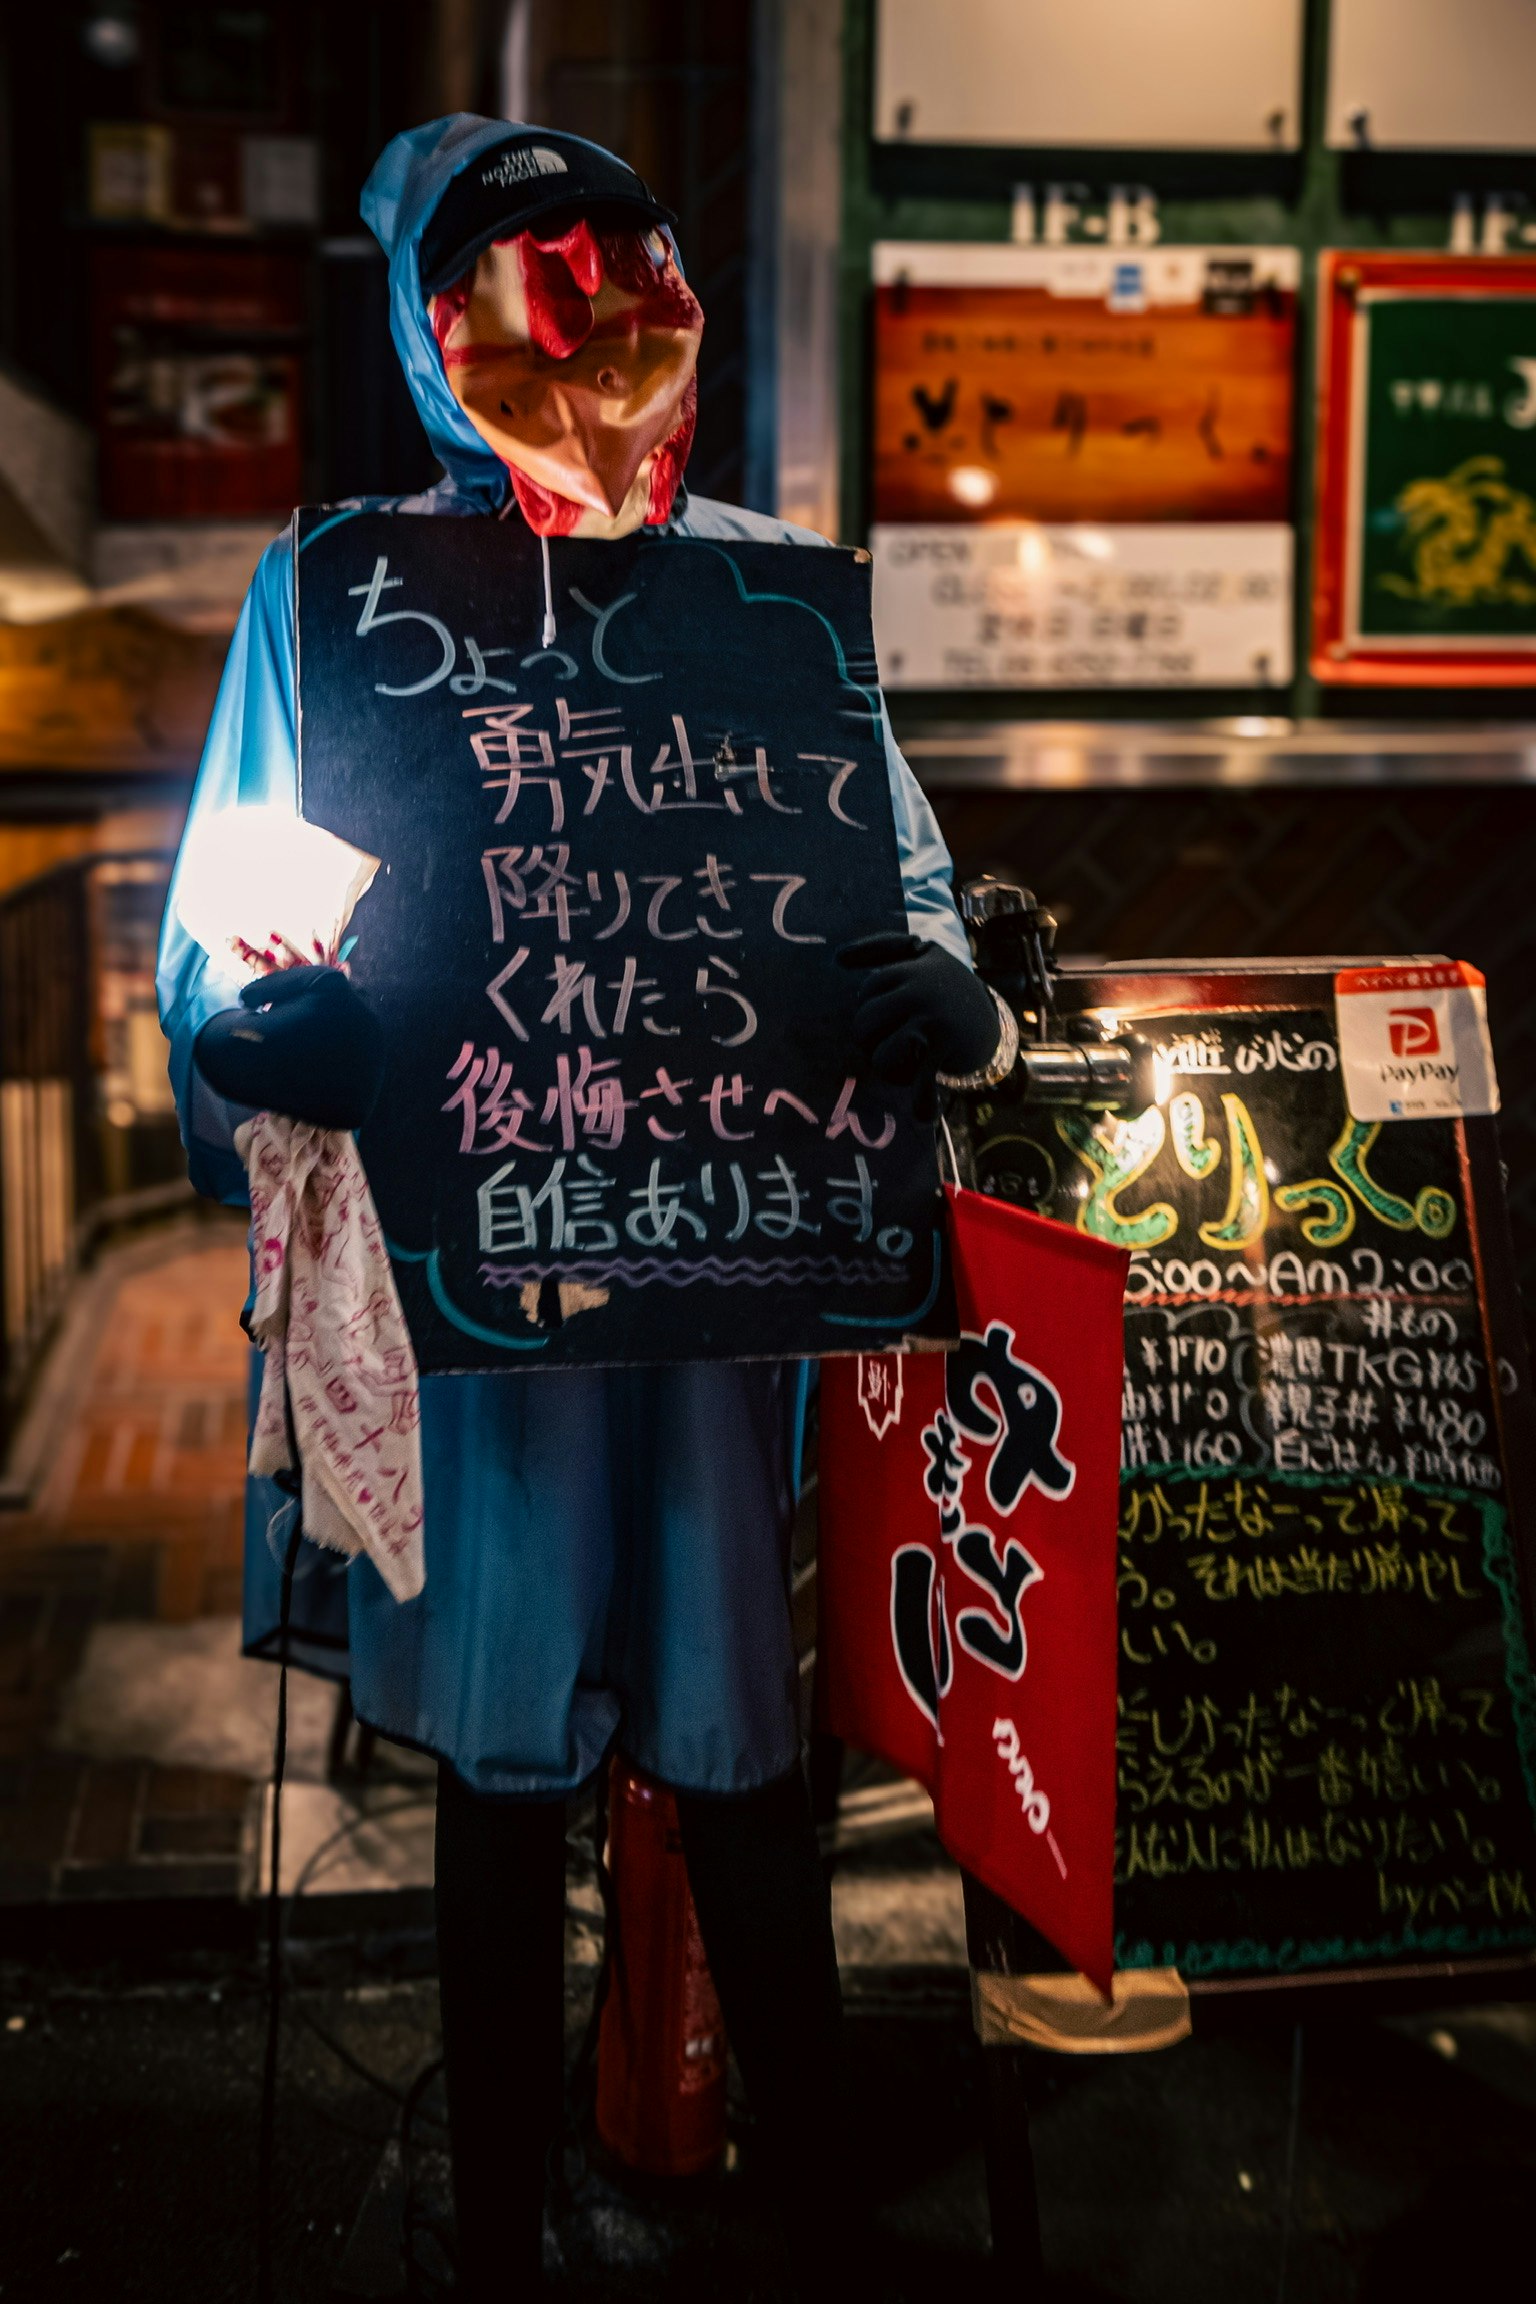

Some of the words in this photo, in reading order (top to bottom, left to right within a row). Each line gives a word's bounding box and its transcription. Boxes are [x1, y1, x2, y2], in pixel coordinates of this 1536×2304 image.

[500, 167, 540, 188] FACE
[501, 147, 531, 165] THE
[348, 556, 662, 698] ちょっと
[463, 698, 868, 833] 勇気出して
[480, 843, 827, 944] 降りてきて
[485, 946, 759, 1047] くれたら
[441, 1041, 897, 1154] 後悔させへん
[1380, 1061, 1460, 1085] PayPay
[476, 1153, 914, 1258] 自信あります。
